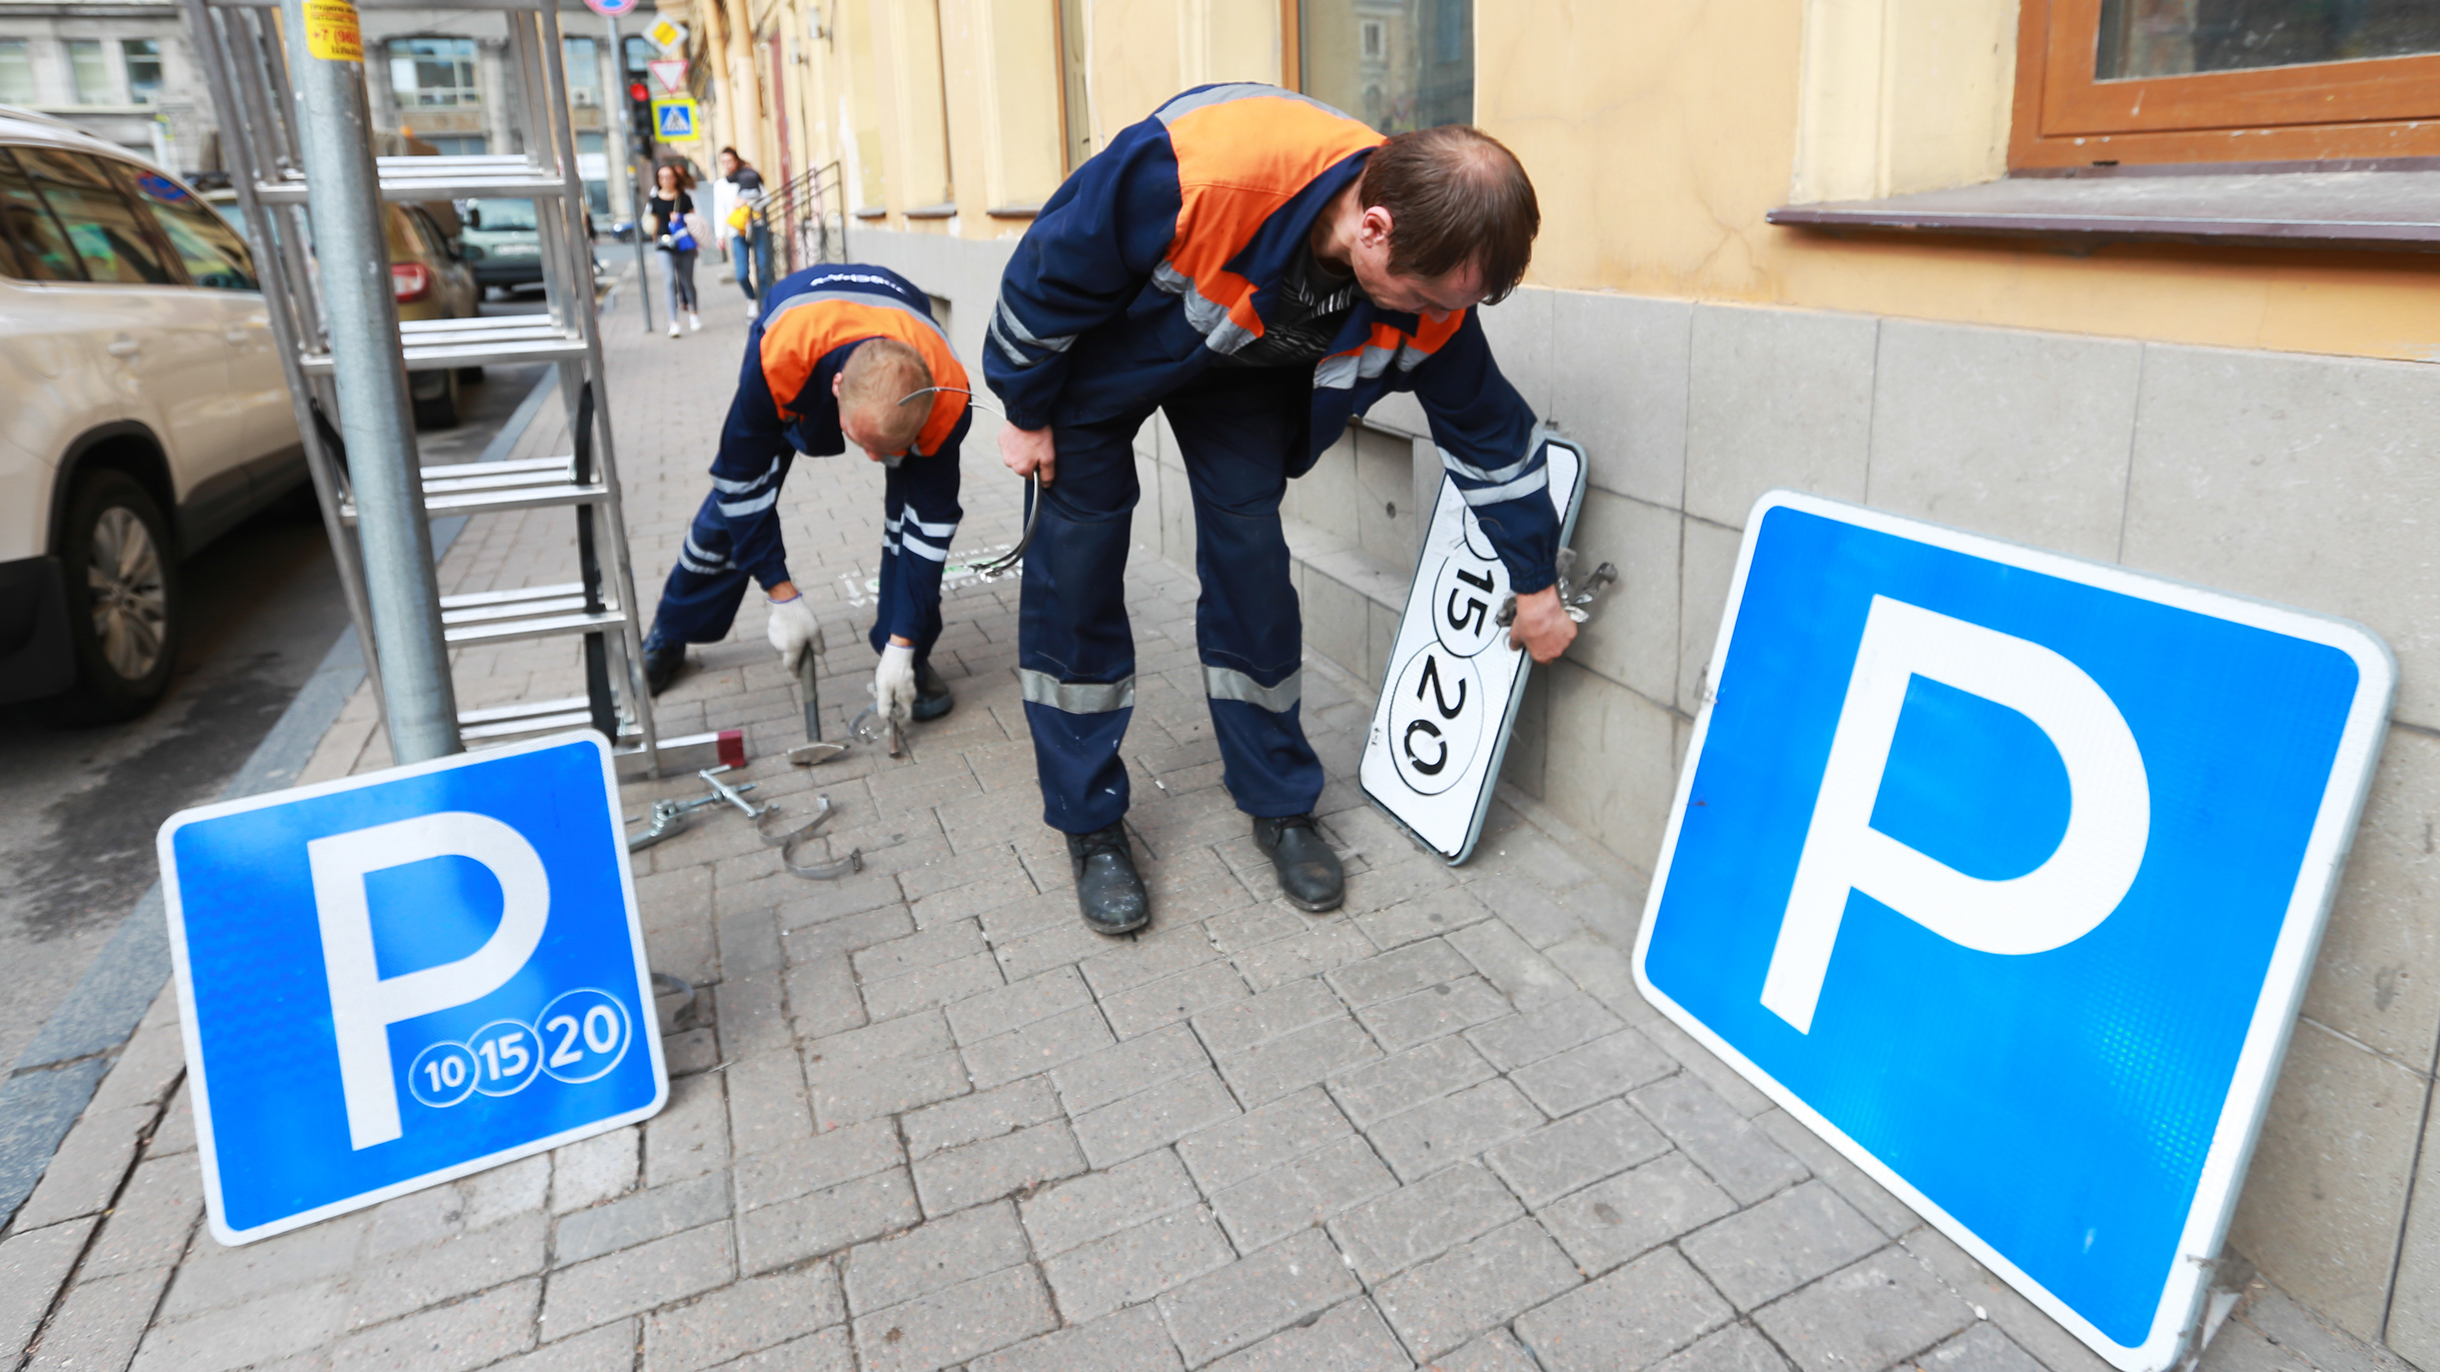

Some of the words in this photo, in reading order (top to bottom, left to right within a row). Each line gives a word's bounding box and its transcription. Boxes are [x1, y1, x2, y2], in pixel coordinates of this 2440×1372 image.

[1447, 568, 1495, 638] 15
[1404, 654, 1466, 776] 20
[1760, 593, 2151, 1035] P
[307, 811, 551, 1151] P
[424, 1055, 466, 1092] 10
[478, 1032, 530, 1081] 15
[545, 1004, 620, 1069] 20
